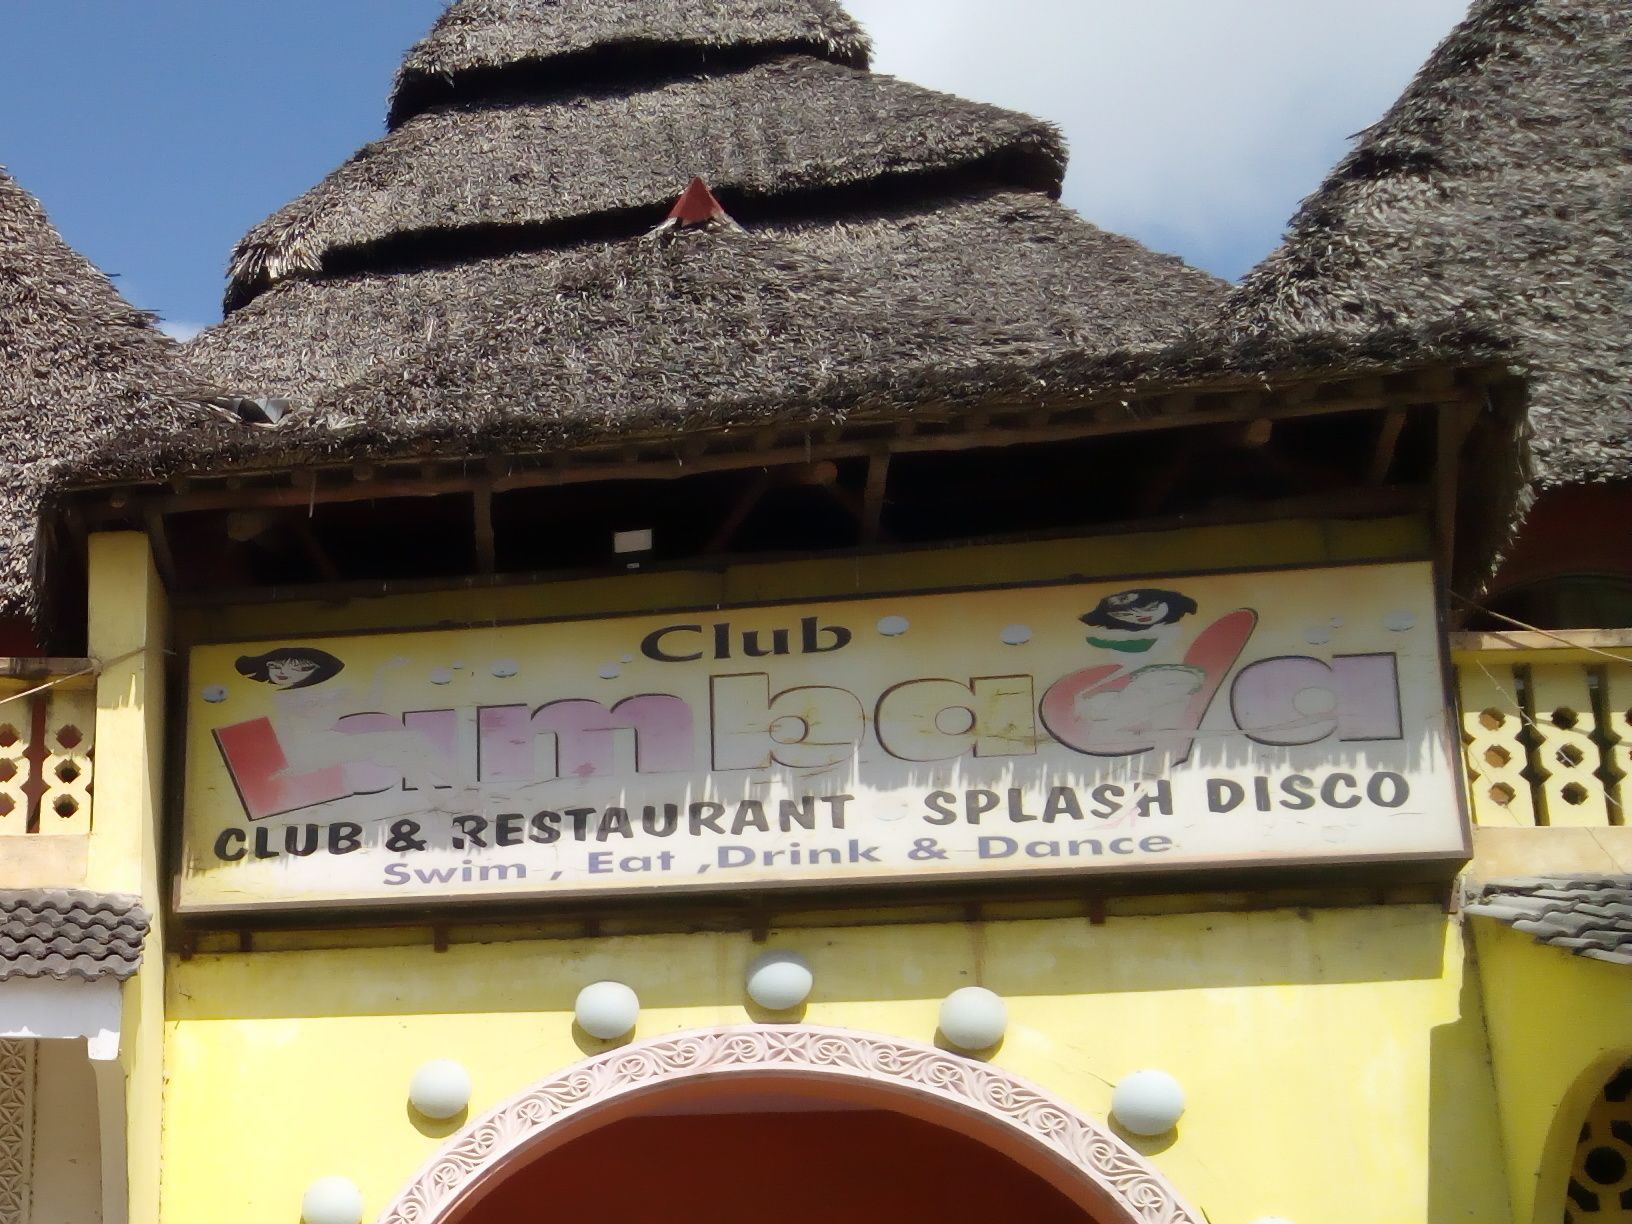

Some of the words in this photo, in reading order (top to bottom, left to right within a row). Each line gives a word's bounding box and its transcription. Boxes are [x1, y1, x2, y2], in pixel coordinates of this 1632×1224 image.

[640, 616, 852, 662] Club
[213, 821, 363, 861] CLUB
[386, 818, 427, 852] &
[451, 794, 855, 850] RESTAURANT
[923, 779, 1174, 825] SPLASH
[1206, 771, 1410, 813] DISCO
[382, 858, 527, 886] Swim
[587, 849, 676, 875] Eat
[906, 837, 950, 861] &
[977, 834, 1174, 860] Dance
